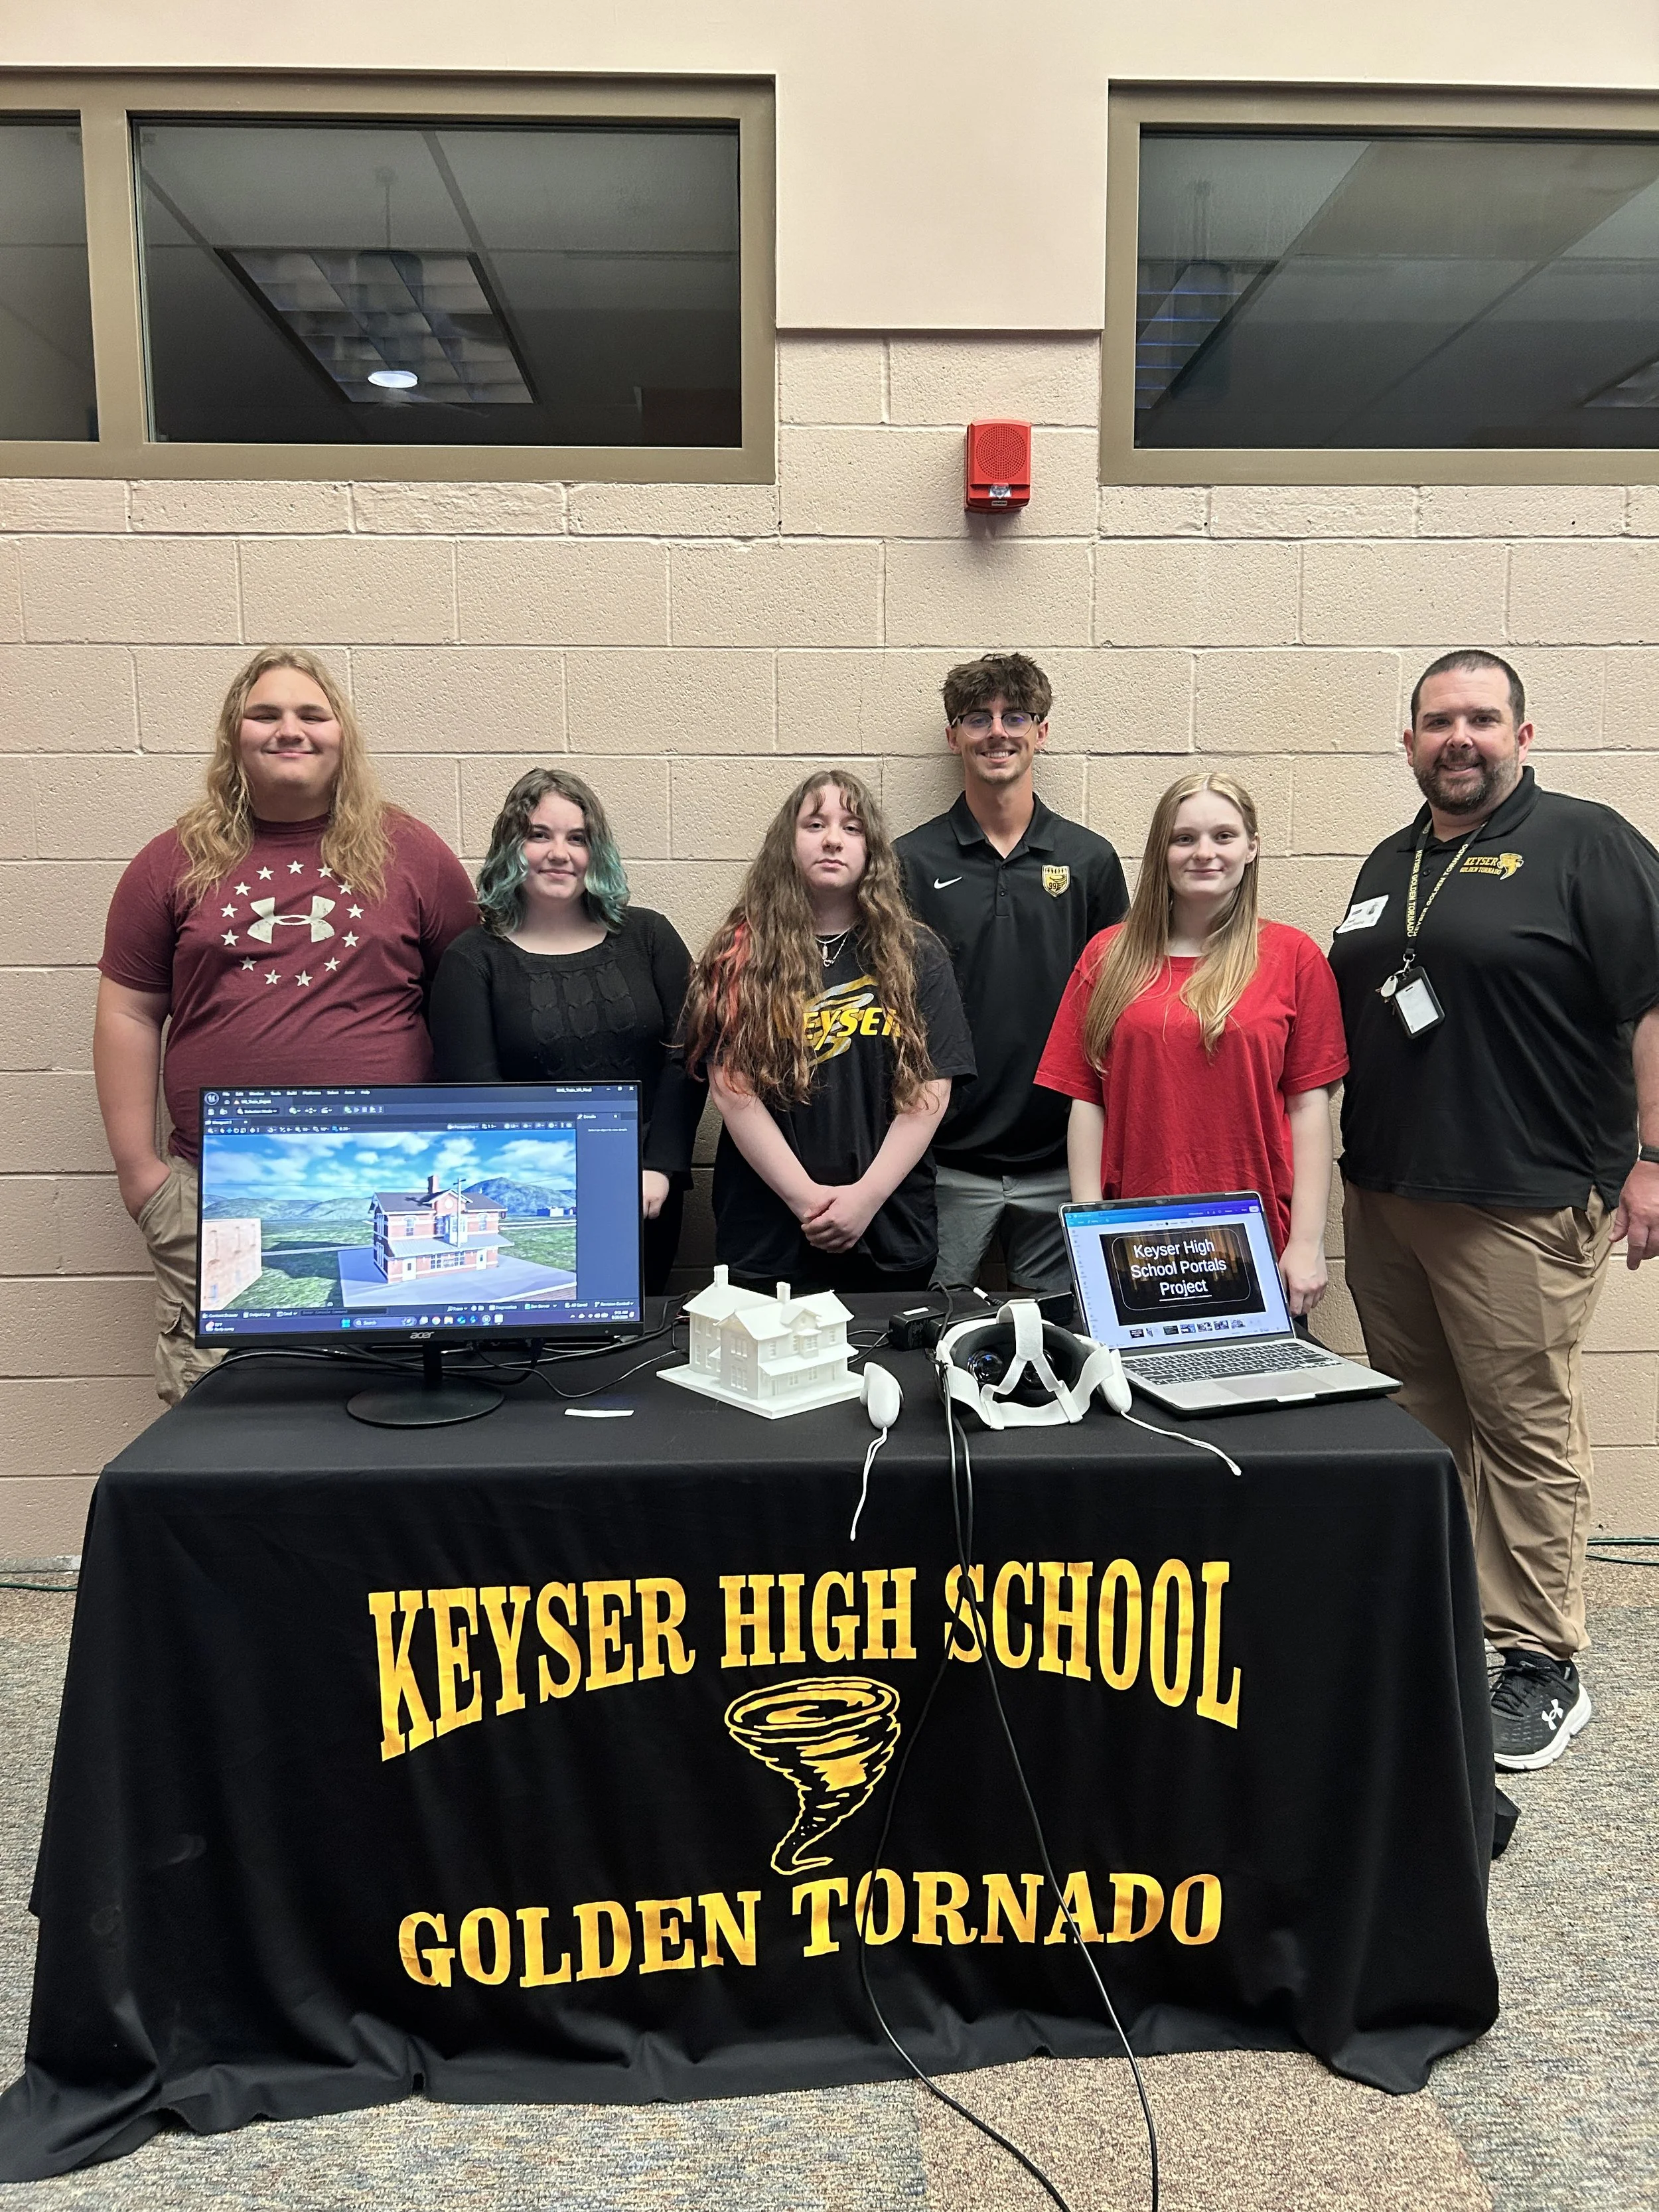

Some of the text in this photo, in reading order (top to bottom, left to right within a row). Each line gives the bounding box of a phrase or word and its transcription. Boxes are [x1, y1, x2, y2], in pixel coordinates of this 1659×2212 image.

[1427, 877, 1447, 906] GOLDEN
[1443, 844, 1469, 876] TORNADO
[1463, 857, 1498, 866] KEYSER
[1409, 874, 1418, 901] GOLDEN
[1407, 901, 1415, 938] TORNADO
[1133, 1239, 1215, 1260] Keyser High
[1130, 1257, 1227, 1278] School Portals
[1159, 1279, 1208, 1297] Project
[369, 1558, 1241, 1761] KEYSER HIGH SCHOOL
[398, 1868, 1222, 1987] GOLDEN TORNADO
